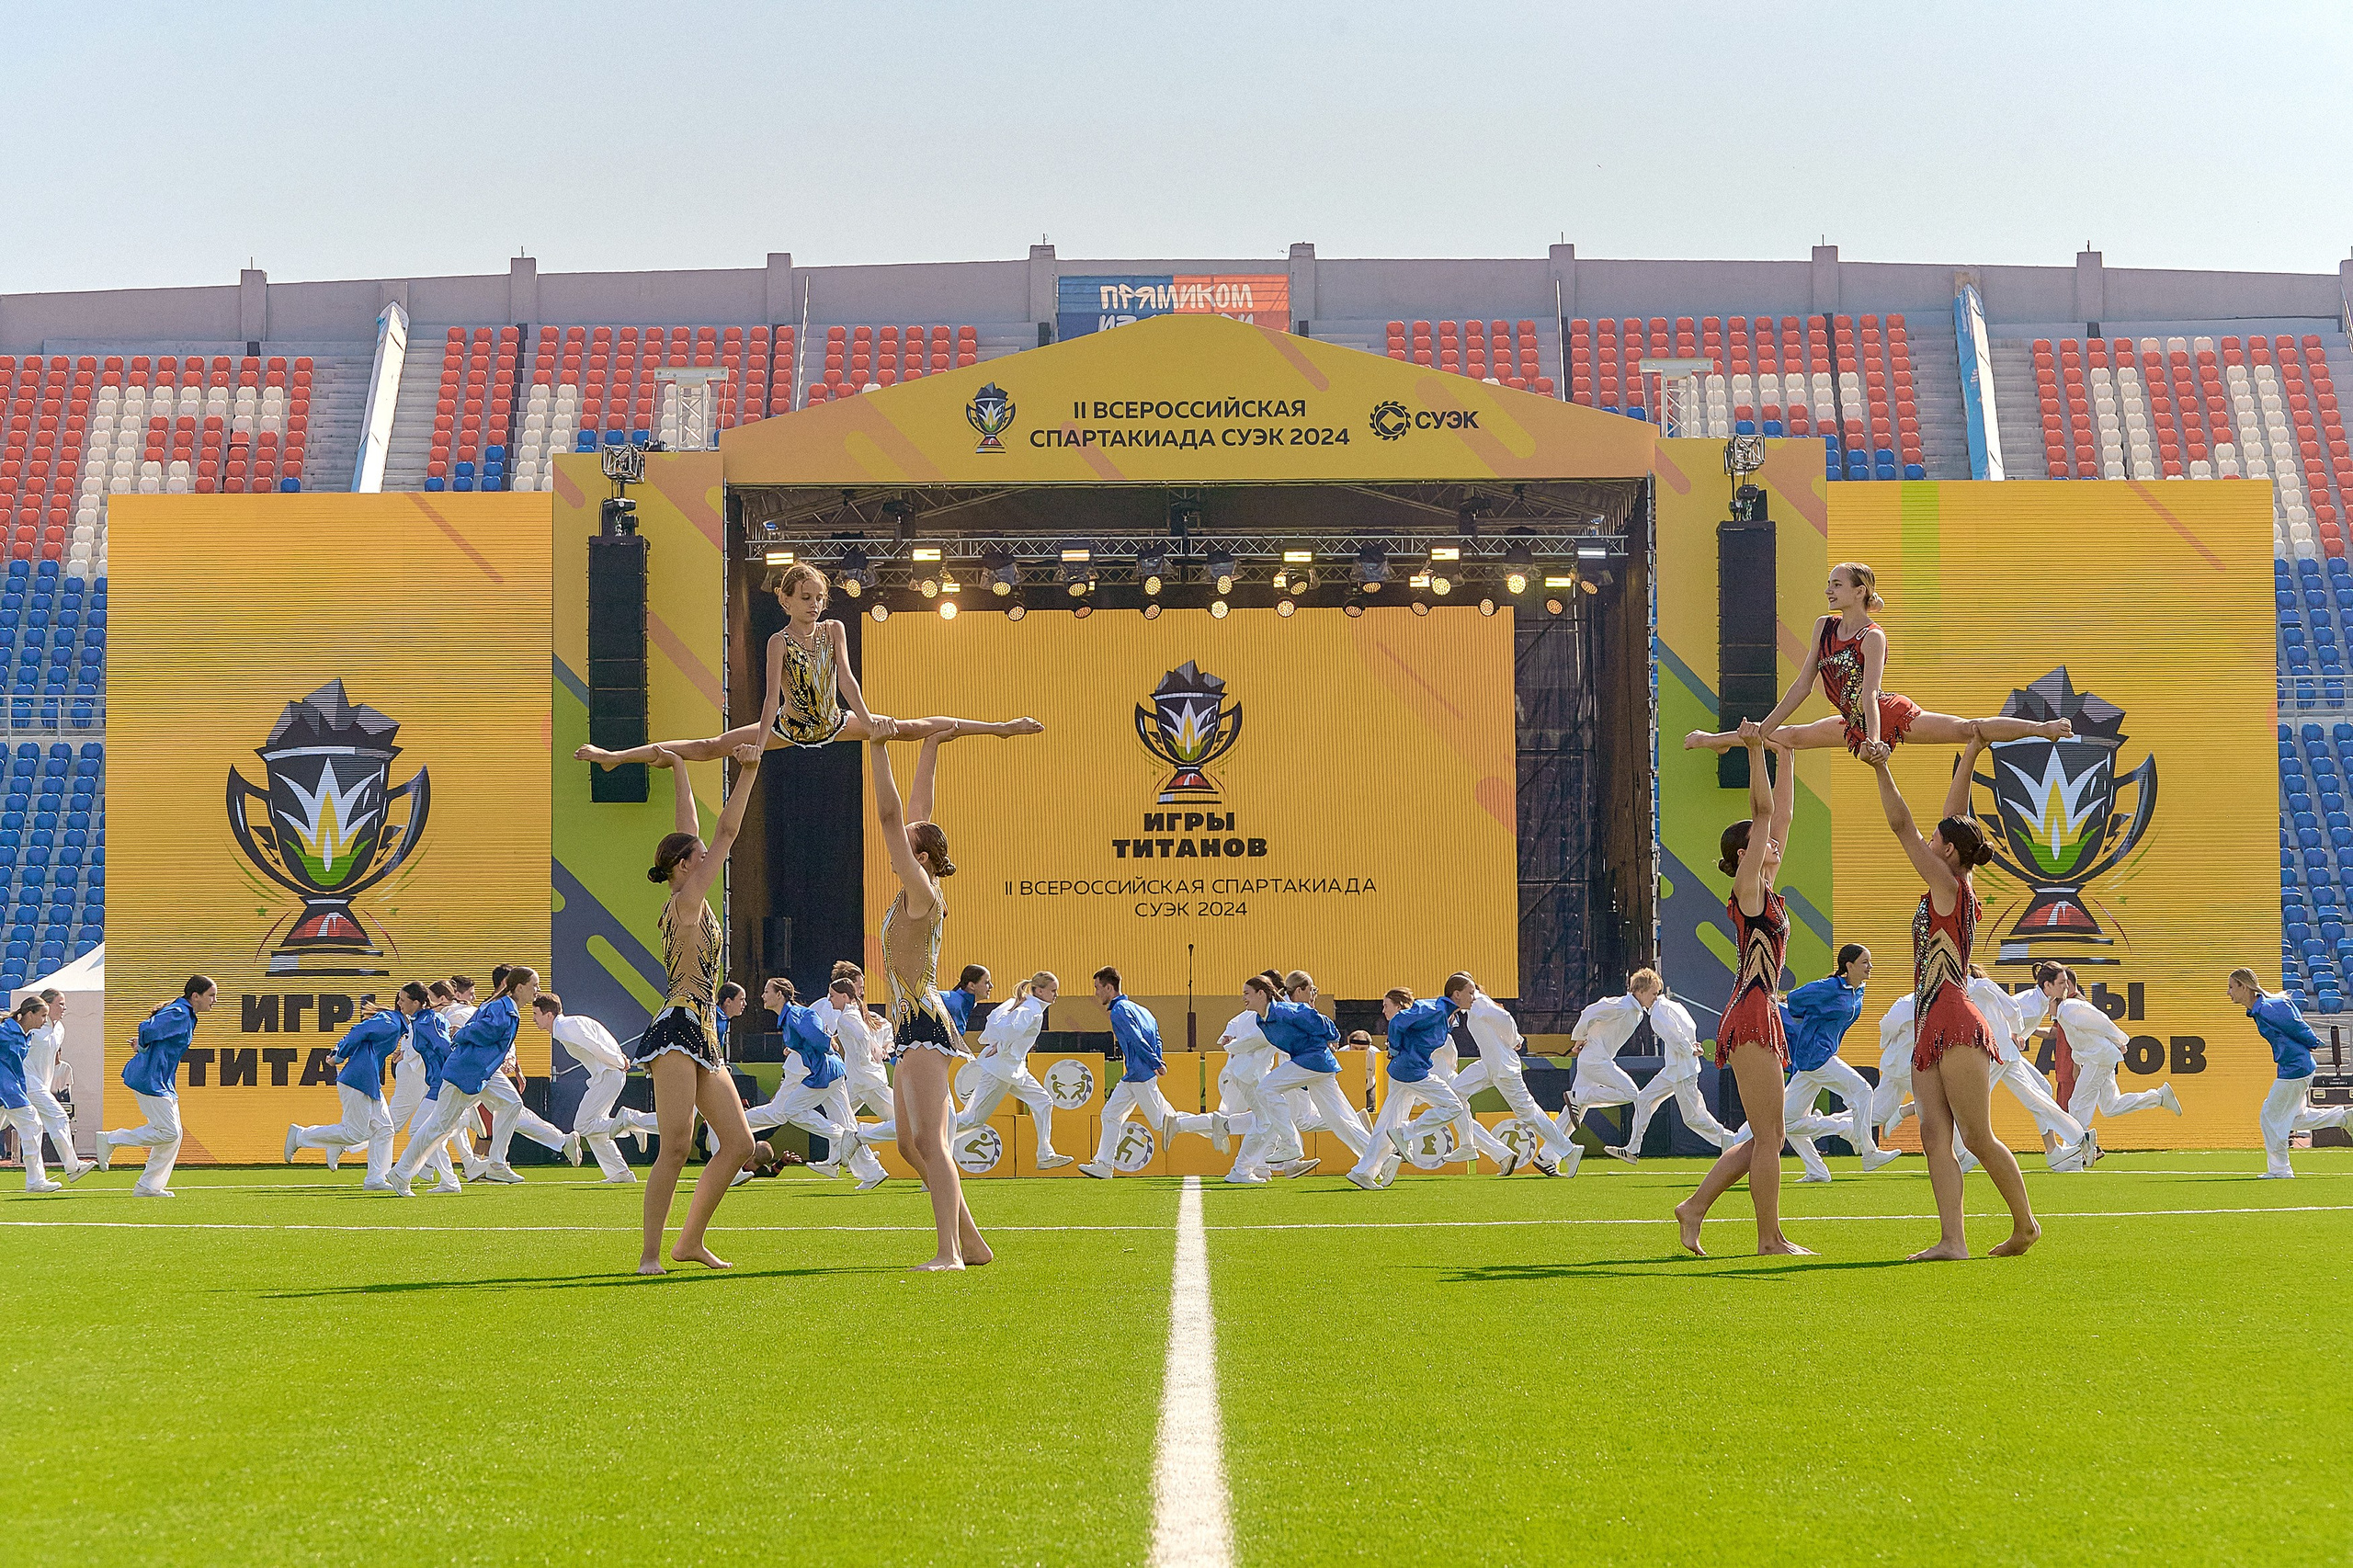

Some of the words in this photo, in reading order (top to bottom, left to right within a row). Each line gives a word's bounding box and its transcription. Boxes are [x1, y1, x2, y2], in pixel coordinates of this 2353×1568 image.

[1099, 283, 1254, 310] ПРЯМИКОМ
[1074, 401, 1086, 419] II
[1093, 396, 1306, 419] ВСЕРОССИЙСКАЯ
[1415, 410, 1480, 430] СУЭК
[1029, 428, 1215, 450] СПАРТАКИАДА
[1222, 427, 1284, 447] СУЭК
[1290, 427, 1350, 446] 2024
[1143, 812, 1235, 832] ИГРЫ
[1111, 838, 1268, 858] ТИТАНОВ
[1019, 876, 1205, 896] ВСЕРОССИЙСКАЯ
[1211, 877, 1378, 896] СПАРТАКИАДА
[1134, 902, 1189, 917] СУЭК
[1198, 901, 1248, 917] 2024
[241, 994, 376, 1032] ИГР
